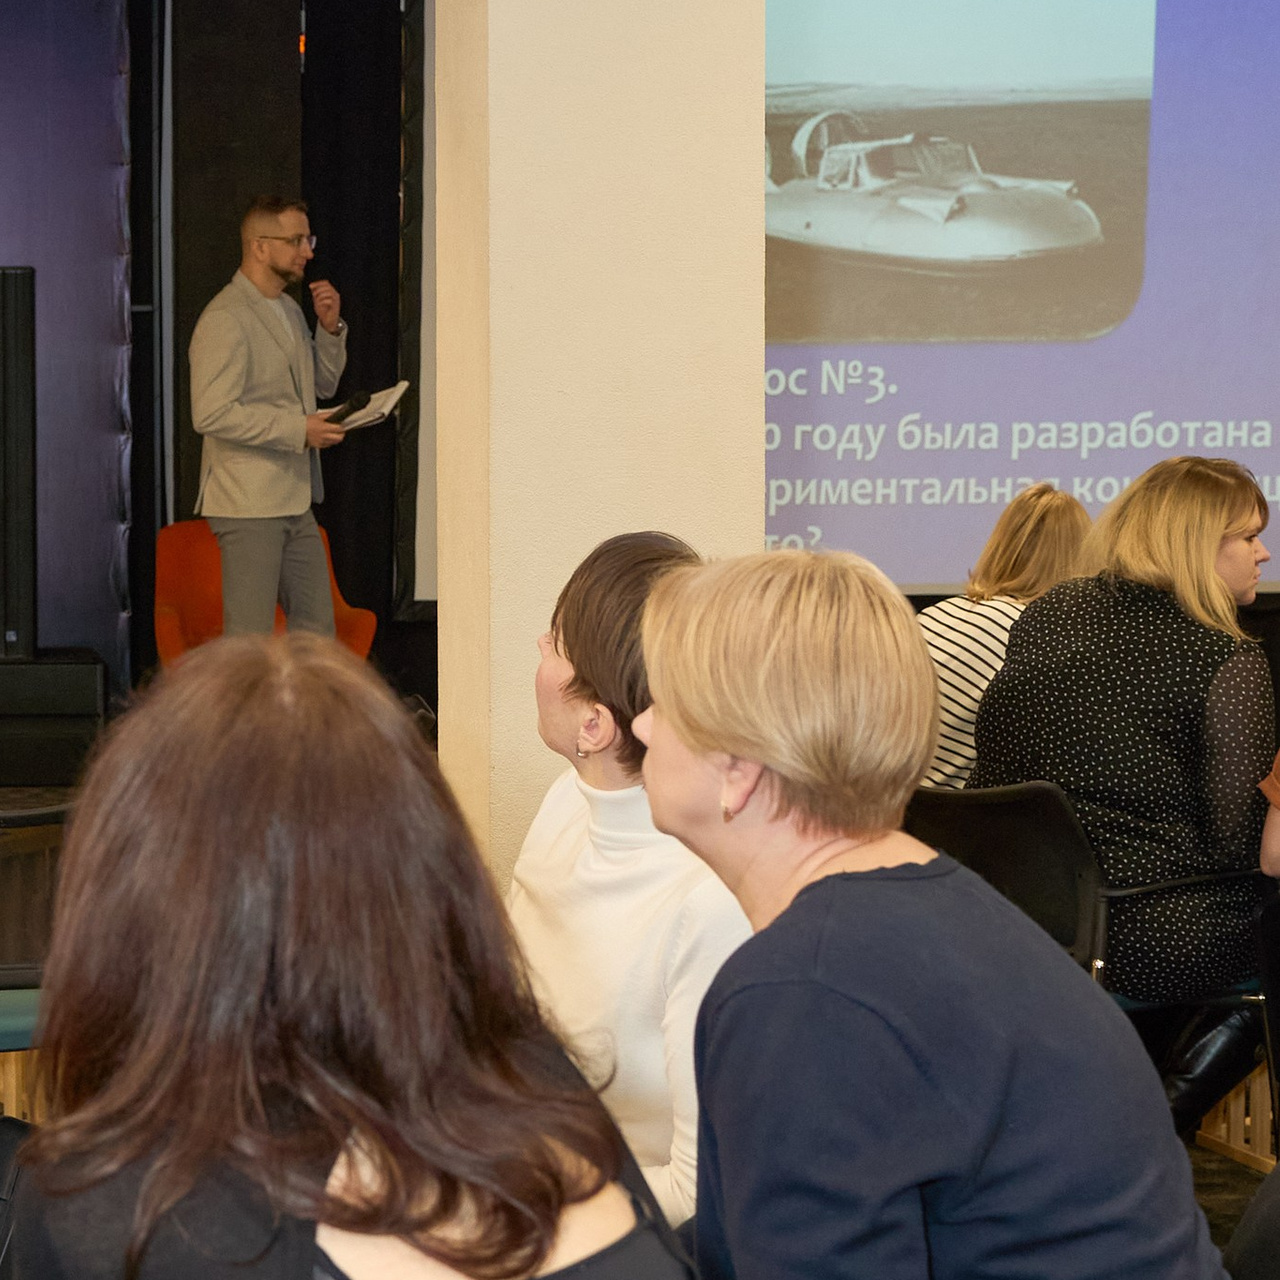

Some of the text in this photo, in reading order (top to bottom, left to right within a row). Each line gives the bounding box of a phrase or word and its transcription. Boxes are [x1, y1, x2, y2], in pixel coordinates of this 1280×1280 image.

[820, 359, 898, 404] №3.
[793, 422, 887, 461] году
[897, 412, 999, 450] была
[1011, 410, 1272, 460] разработана
